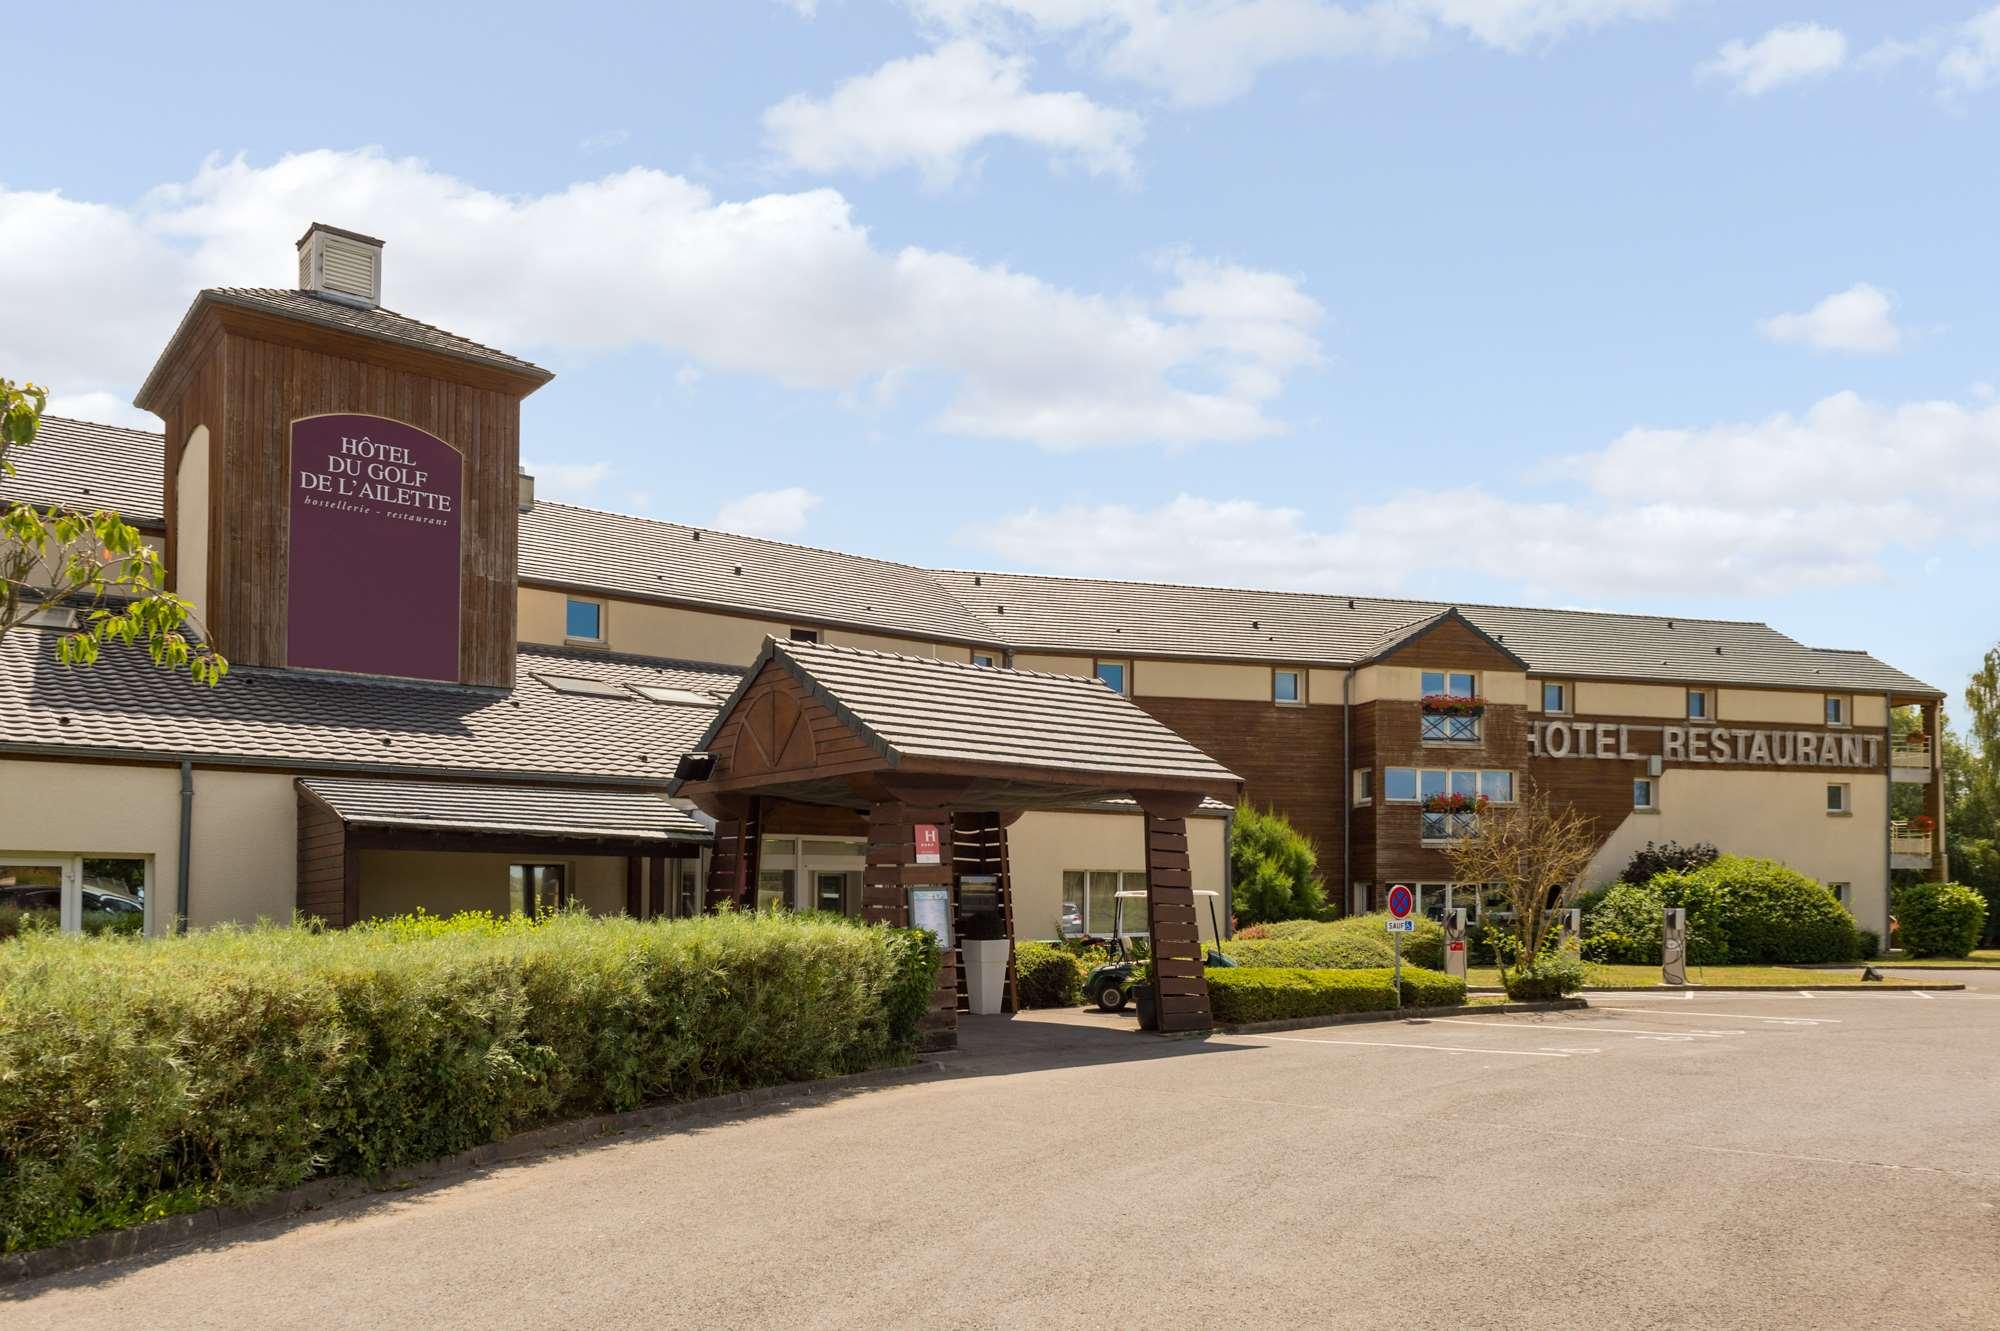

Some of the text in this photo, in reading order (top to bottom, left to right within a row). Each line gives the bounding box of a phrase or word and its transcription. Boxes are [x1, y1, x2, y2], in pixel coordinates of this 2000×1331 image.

[340, 436, 416, 466] HÔTEL
[300, 471, 332, 492] DE
[328, 455, 428, 487] DU GOLF
[304, 495, 371, 514] hostellerie
[387, 511, 448, 526] restaurant
[1663, 725, 1884, 768] RESTAURANT
[925, 830, 936, 842] H
[1388, 921, 1404, 930] SAUF
